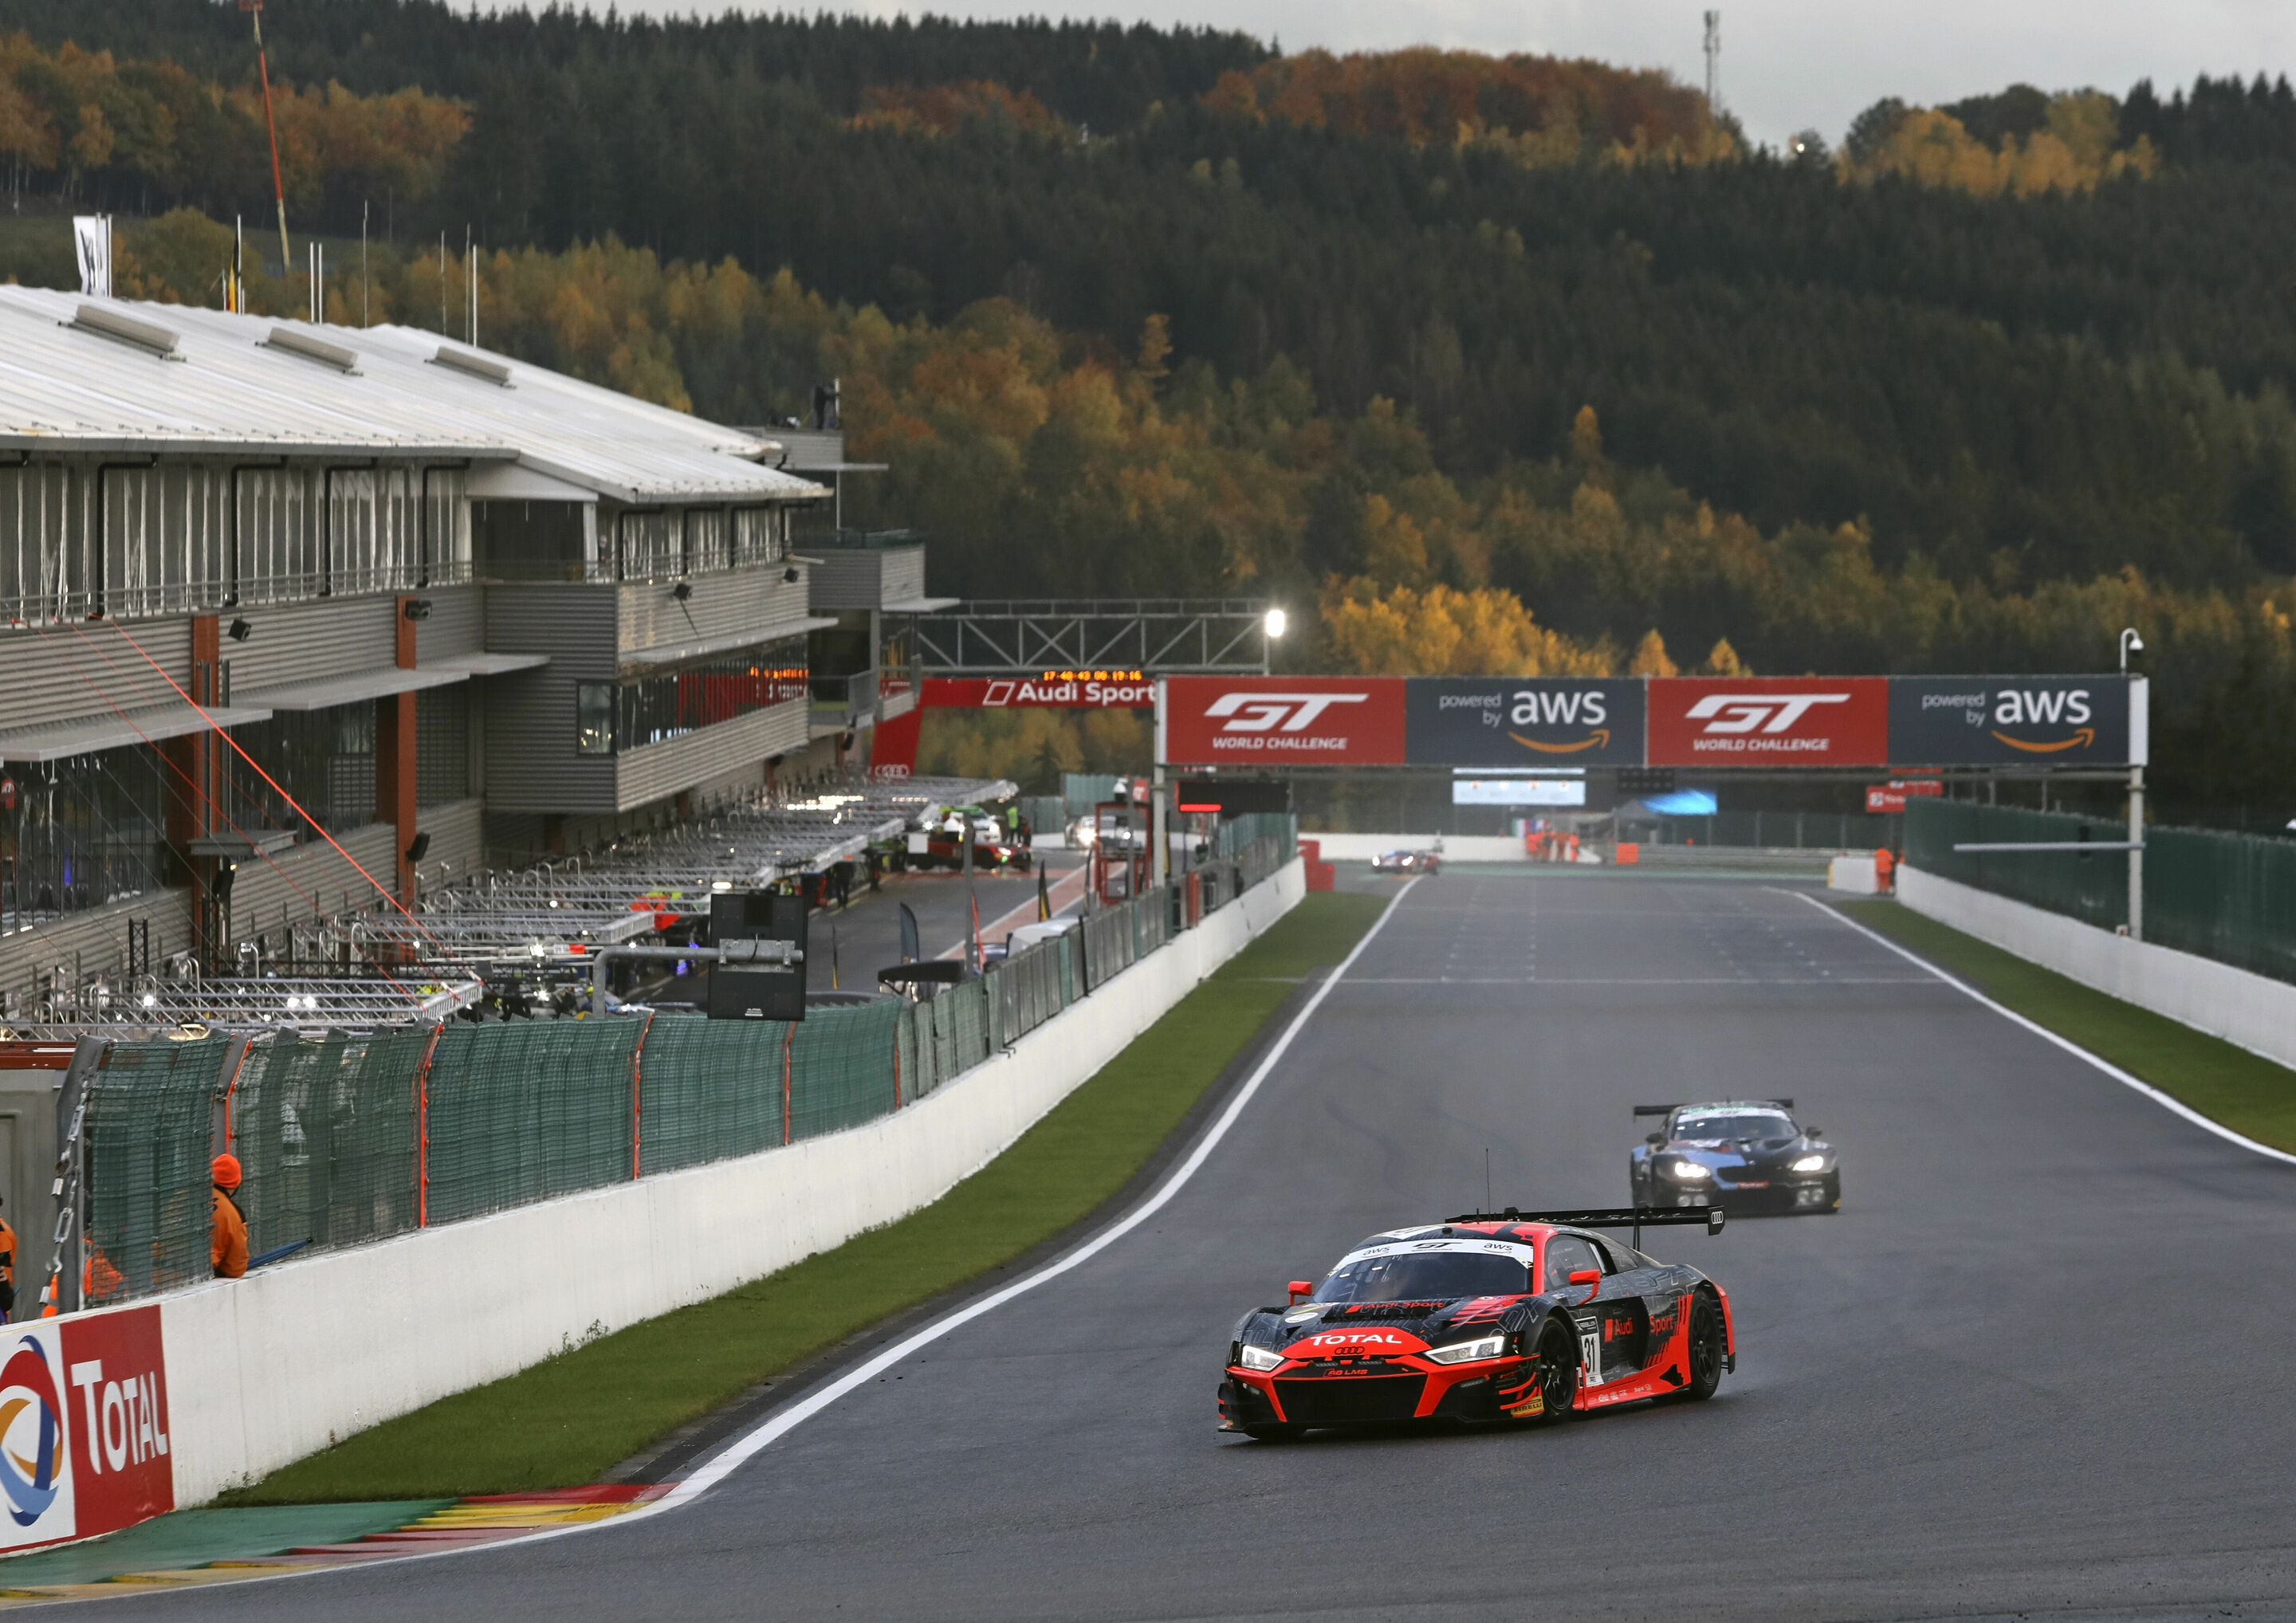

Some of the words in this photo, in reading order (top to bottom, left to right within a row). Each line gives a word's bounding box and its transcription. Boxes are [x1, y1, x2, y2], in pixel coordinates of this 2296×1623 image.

[1016, 682, 1078, 702] Audi
[1085, 682, 1155, 707] Sport
[1439, 693, 1502, 709] powered
[1922, 690, 1986, 710] powered
[1204, 693, 1370, 731] GT
[1511, 690, 1606, 725] aws
[1685, 694, 1851, 733] GT
[1995, 690, 2091, 725] aws
[1482, 709, 1503, 729] by
[1965, 709, 1987, 727] by
[1213, 737, 1264, 749] WORLD
[1266, 737, 1347, 750] CHALLENGE
[1693, 738, 1746, 751] WORLD
[1748, 737, 1829, 751] CHALLENGE
[1363, 1246, 1390, 1256] aws
[1484, 1242, 1513, 1252] aws
[1614, 1317, 1634, 1336] Audi
[1649, 1315, 1674, 1336] Sport
[1310, 1334, 1403, 1346] TOTAL
[1584, 1336, 1596, 1374] 31
[70, 1359, 168, 1475] TOTAL
